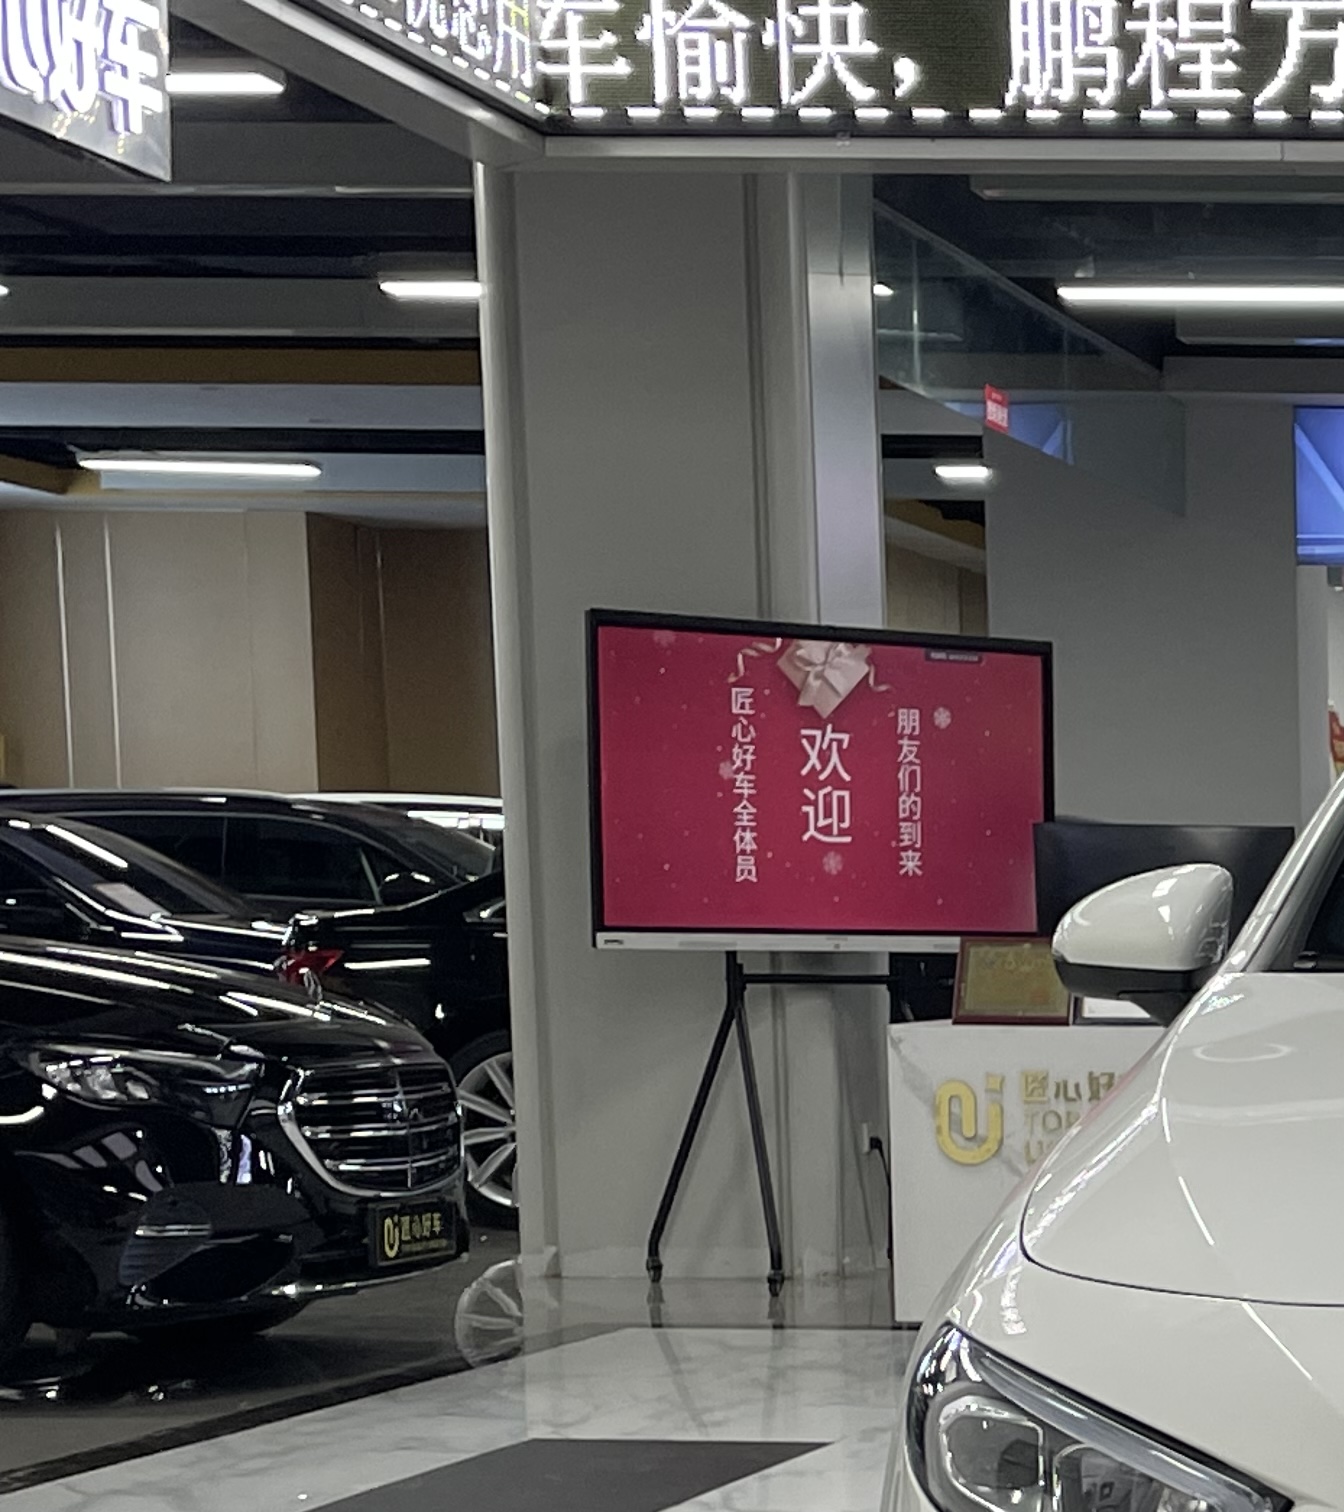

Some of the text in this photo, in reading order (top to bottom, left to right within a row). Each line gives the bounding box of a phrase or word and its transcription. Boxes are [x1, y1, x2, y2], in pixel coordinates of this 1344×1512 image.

[730, 687, 758, 884] 匠心好车全体员
[800, 723, 853, 844] 欢迎
[896, 707, 923, 878] 朋友们的到来
